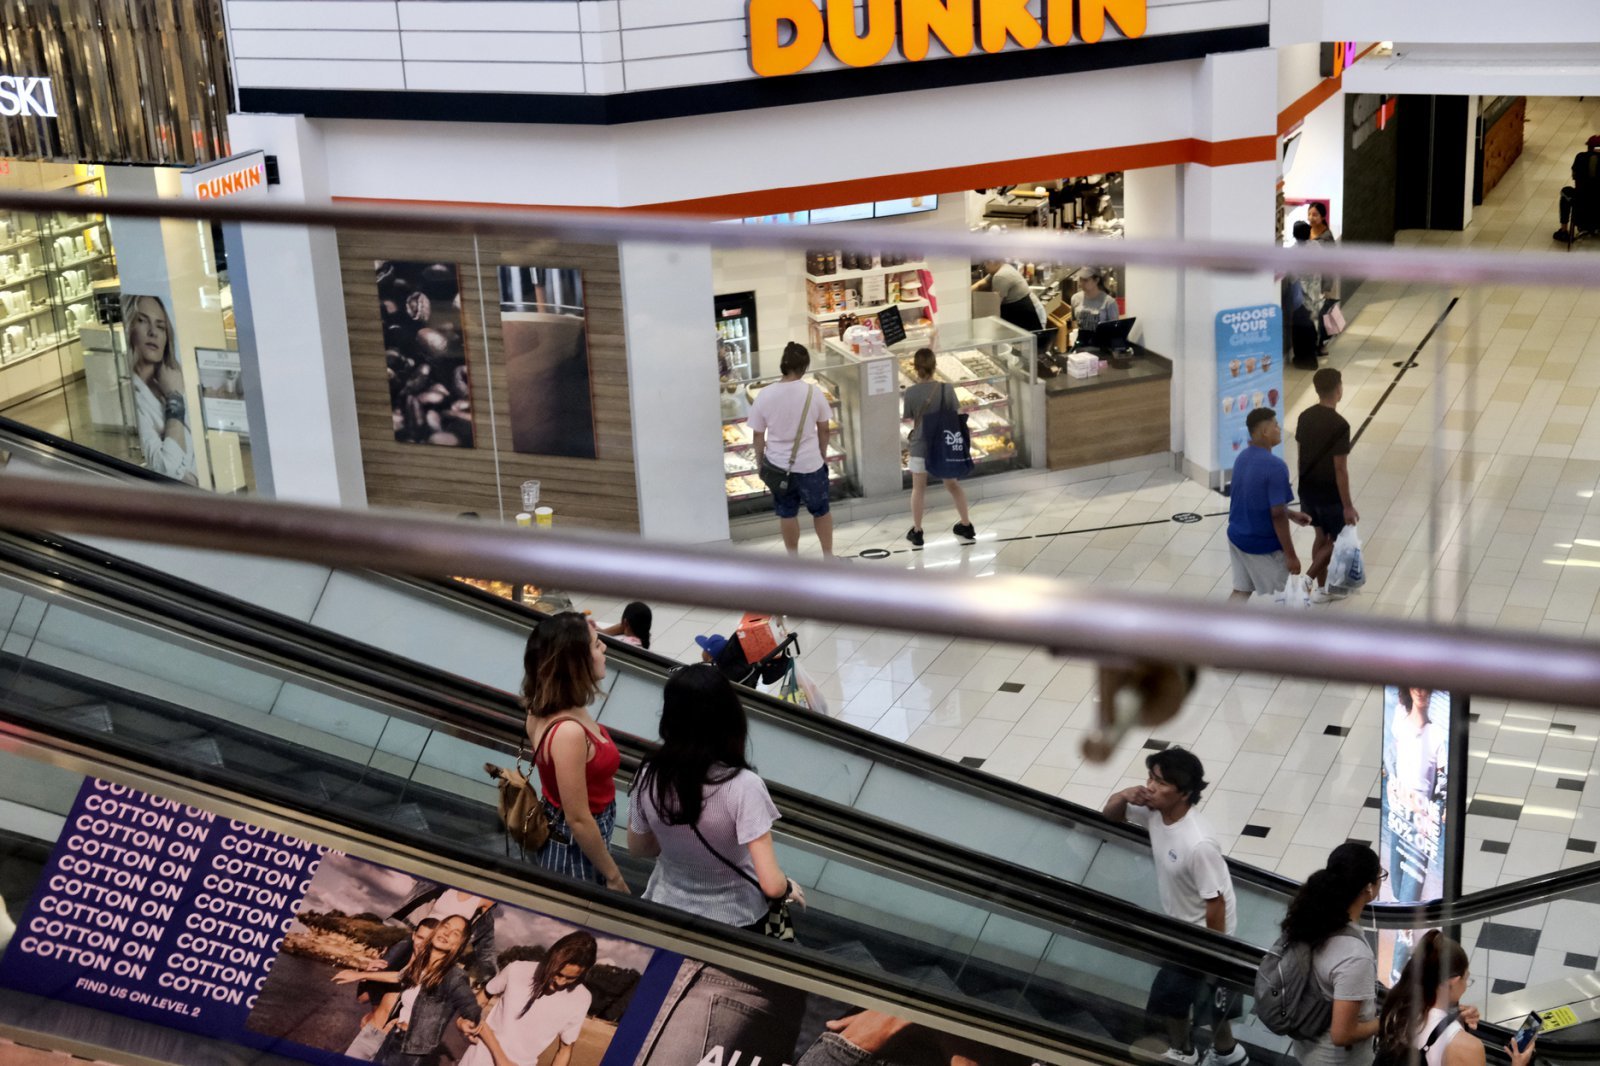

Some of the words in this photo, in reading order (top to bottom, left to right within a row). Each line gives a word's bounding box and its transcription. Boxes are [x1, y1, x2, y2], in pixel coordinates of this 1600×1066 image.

[0, 76, 57, 117] SKI
[1222, 307, 1276, 324] CHOOSE
[1232, 319, 1268, 334] YOUR
[86, 795, 174, 832] COTTON
[177, 822, 209, 842] ON
[76, 815, 165, 852] COTTON
[168, 842, 200, 862] ON
[221, 835, 305, 870] COTTON
[68, 835, 156, 871] COTTON
[159, 862, 191, 881] ON
[212, 855, 296, 890] COTTON
[59, 855, 147, 891] COTTON
[150, 881, 183, 901] ON
[204, 874, 287, 909] COTTON
[50, 875, 138, 912] COTTON
[141, 901, 174, 921] ON
[195, 894, 278, 928] COTTON
[40, 896, 129, 932] COTTON
[132, 922, 164, 941] ON
[186, 914, 270, 948] COTTON
[30, 917, 120, 951] COTTON
[123, 942, 155, 961] ON
[177, 934, 260, 967] COTTON
[21, 937, 110, 970] COTTON
[114, 961, 146, 980] ON
[168, 954, 252, 986] COTTON
[76, 978, 107, 993] FIND
[110, 986, 128, 998] US
[129, 991, 151, 1004] ON
[152, 997, 188, 1013] LEVEL
[191, 1007, 201, 1016] 2
[159, 973, 243, 1004] COTTON
